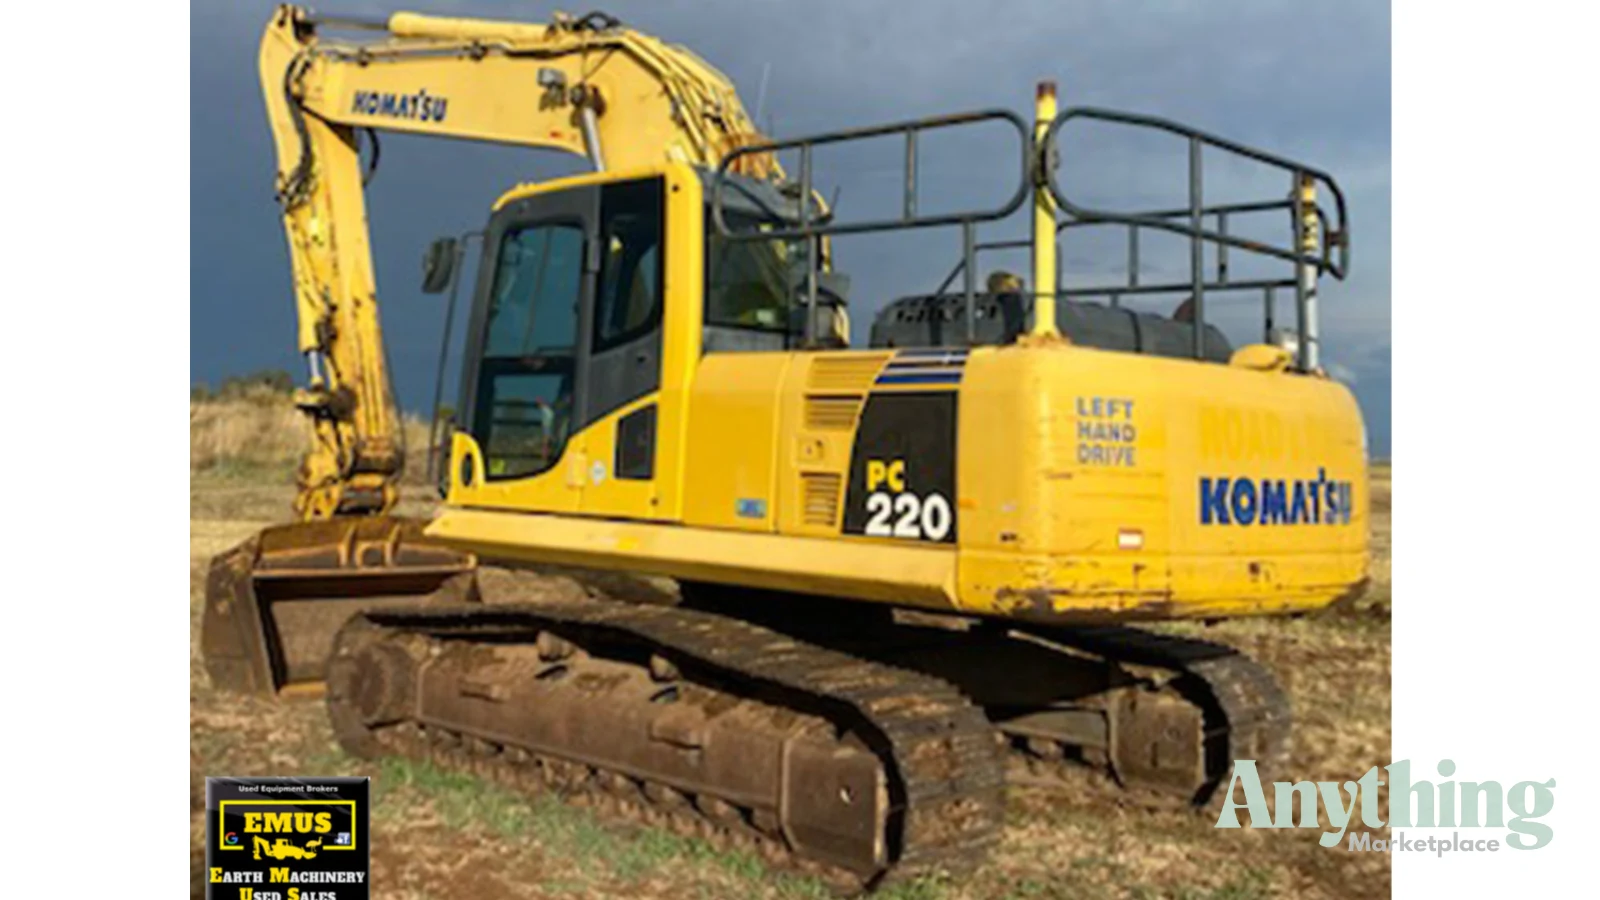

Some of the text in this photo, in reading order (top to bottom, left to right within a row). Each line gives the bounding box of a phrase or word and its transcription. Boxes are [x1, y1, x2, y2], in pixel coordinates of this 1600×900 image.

[1076, 397, 1135, 418] LEFT
[1077, 422, 1136, 442] HAND
[1077, 446, 1136, 467] DRIVE
[867, 460, 904, 491] PC
[865, 493, 951, 541] 220
